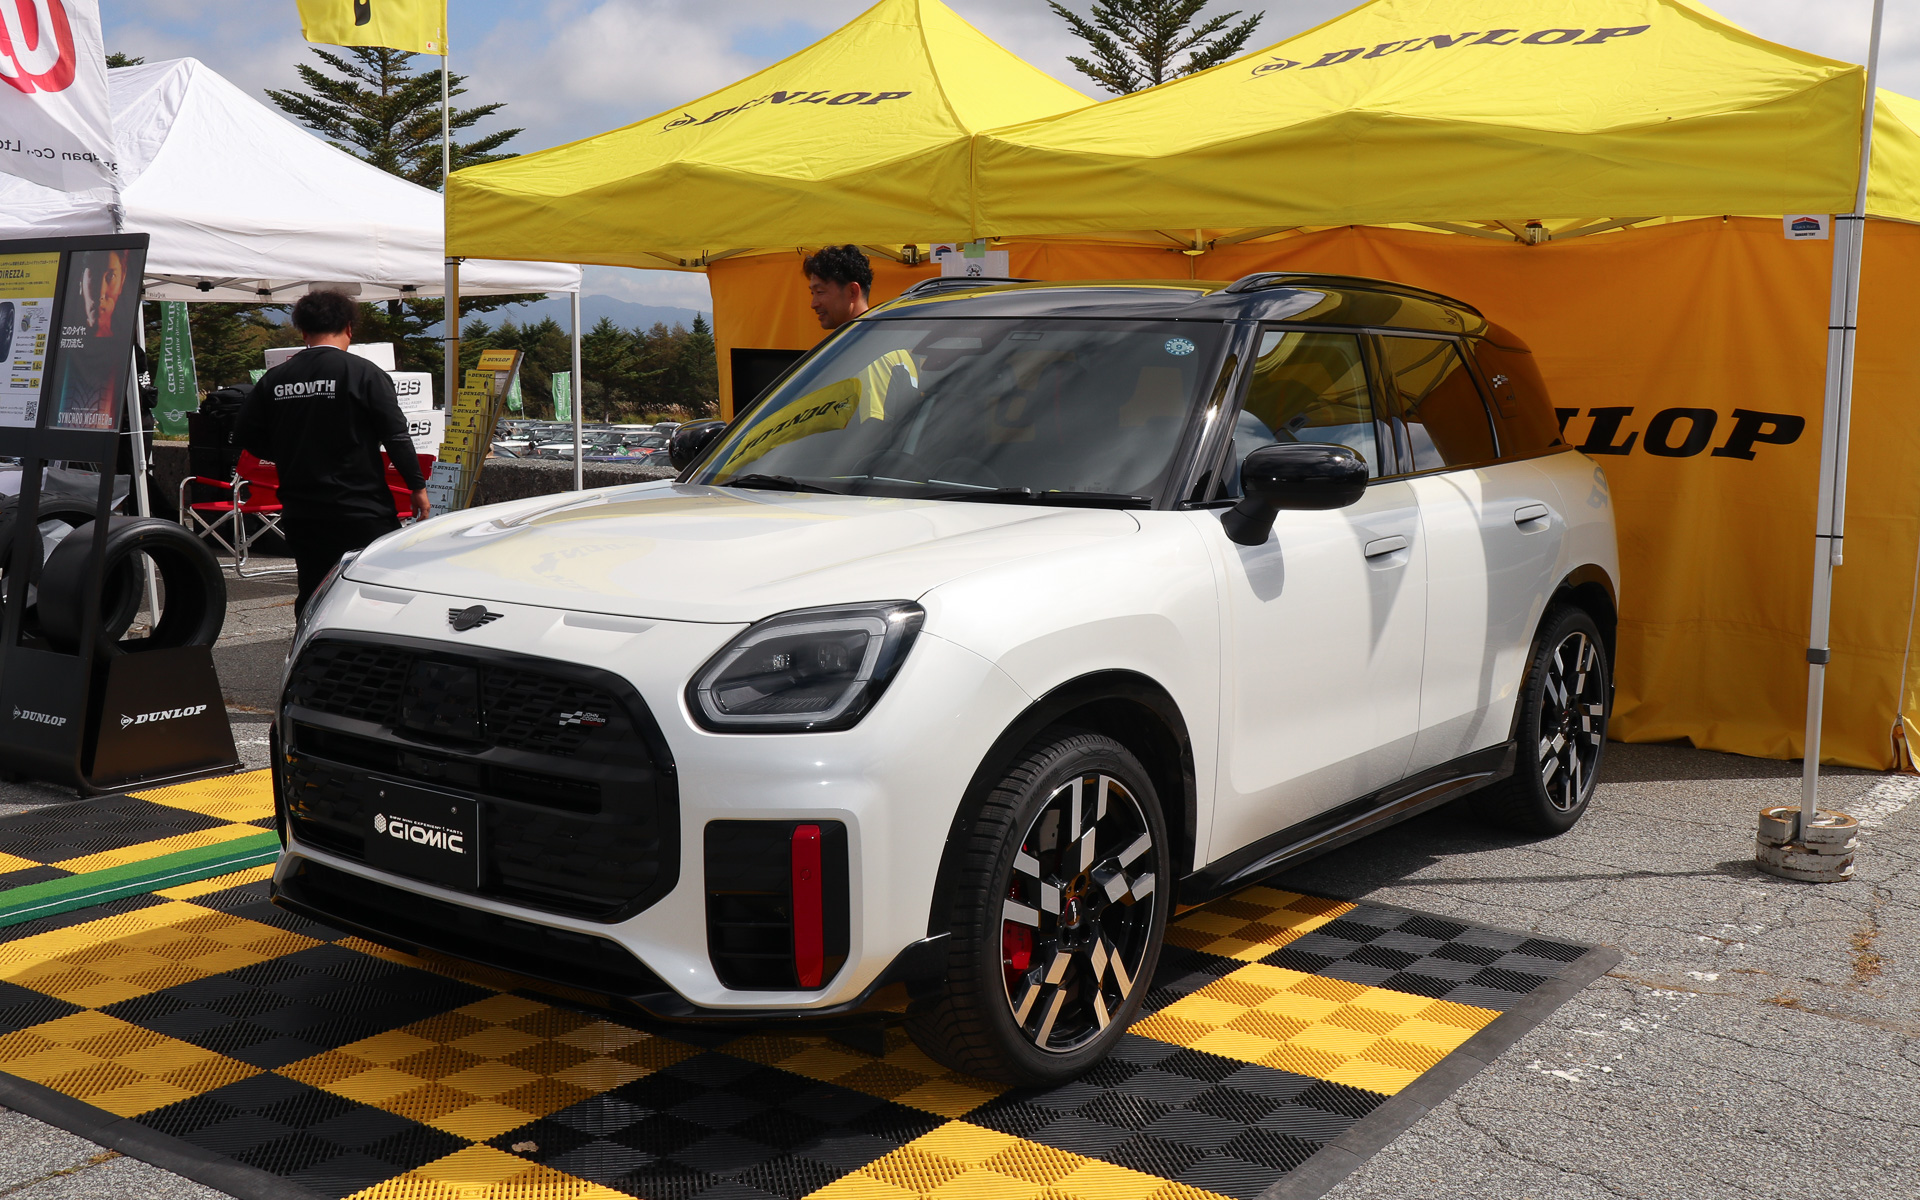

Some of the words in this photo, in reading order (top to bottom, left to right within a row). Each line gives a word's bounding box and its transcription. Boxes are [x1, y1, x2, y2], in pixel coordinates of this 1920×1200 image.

[1300, 25, 1651, 70] DUNLOP
[274, 380, 336, 397] GROWTH
[58, 411, 82, 424] SYNCHRO
[84, 412, 109, 426] WEATHER
[405, 419, 431, 436] BS
[1555, 407, 1806, 461] LOP
[20, 709, 66, 727] DUNLOP
[134, 704, 207, 725] DUNLOP
[389, 820, 463, 853] GIOMIC
